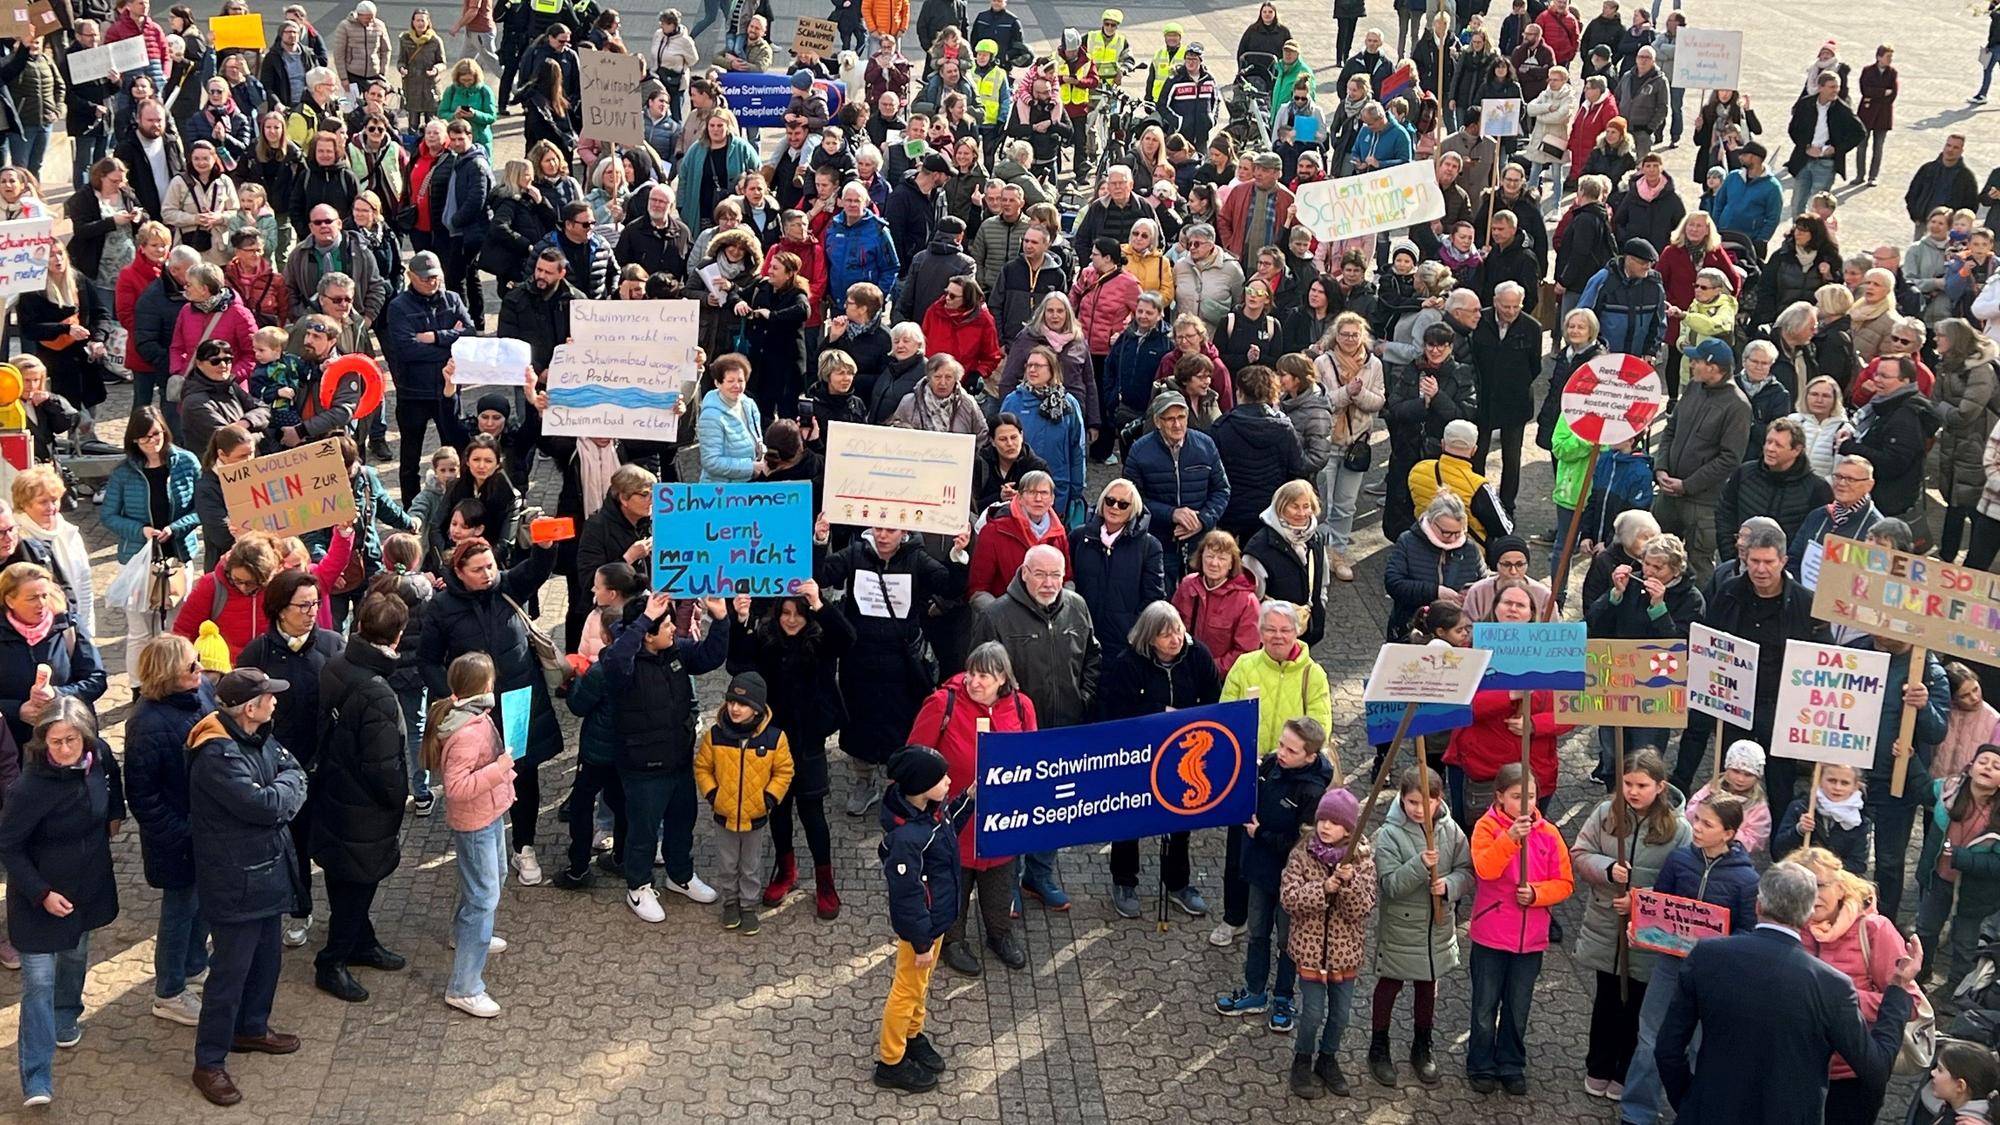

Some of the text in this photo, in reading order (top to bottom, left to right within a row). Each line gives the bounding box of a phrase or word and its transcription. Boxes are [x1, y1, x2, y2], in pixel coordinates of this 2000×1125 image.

[590, 106, 639, 129] BUNT
[1328, 215, 1352, 237] nicht
[574, 305, 650, 323] Schwimmen
[594, 329, 680, 342] man nicht im
[554, 350, 577, 365] Ein
[582, 351, 648, 368] Schwimmbad
[560, 372, 581, 384] ein
[586, 368, 631, 384] Problem
[1583, 398, 1610, 408] kostet
[549, 406, 624, 427] Schwimmbad
[1602, 413, 1616, 421] das
[222, 451, 308, 484] WIR WOLLEN
[250, 473, 339, 510] NEIN ZUR
[658, 486, 800, 513] Schwimmen
[658, 540, 797, 565] man nicht
[1825, 539, 1928, 583] KINDER
[658, 565, 802, 596] Zuhause
[1480, 628, 1578, 642] KINDER WOLLEN
[1710, 635, 1735, 654] KEIN
[1546, 646, 1587, 658] LERNEN
[1691, 643, 1754, 671] SCHWIMMBAD
[1817, 651, 1858, 670] DAS
[1709, 670, 1738, 691] KEIN
[1791, 669, 1883, 694] SCHWIMM-
[1690, 690, 1752, 722] PFERDCHEN
[1809, 689, 1857, 709] BAD
[1797, 707, 1850, 731] SOLL
[1788, 727, 1871, 751] BLEIBEN!
[985, 744, 1152, 785] Kein Schwimmbad
[983, 790, 1152, 832] Kein Seepferdchen
[1664, 897, 1711, 916] brauchen
[1640, 905, 1723, 933] das Schwimmbad
